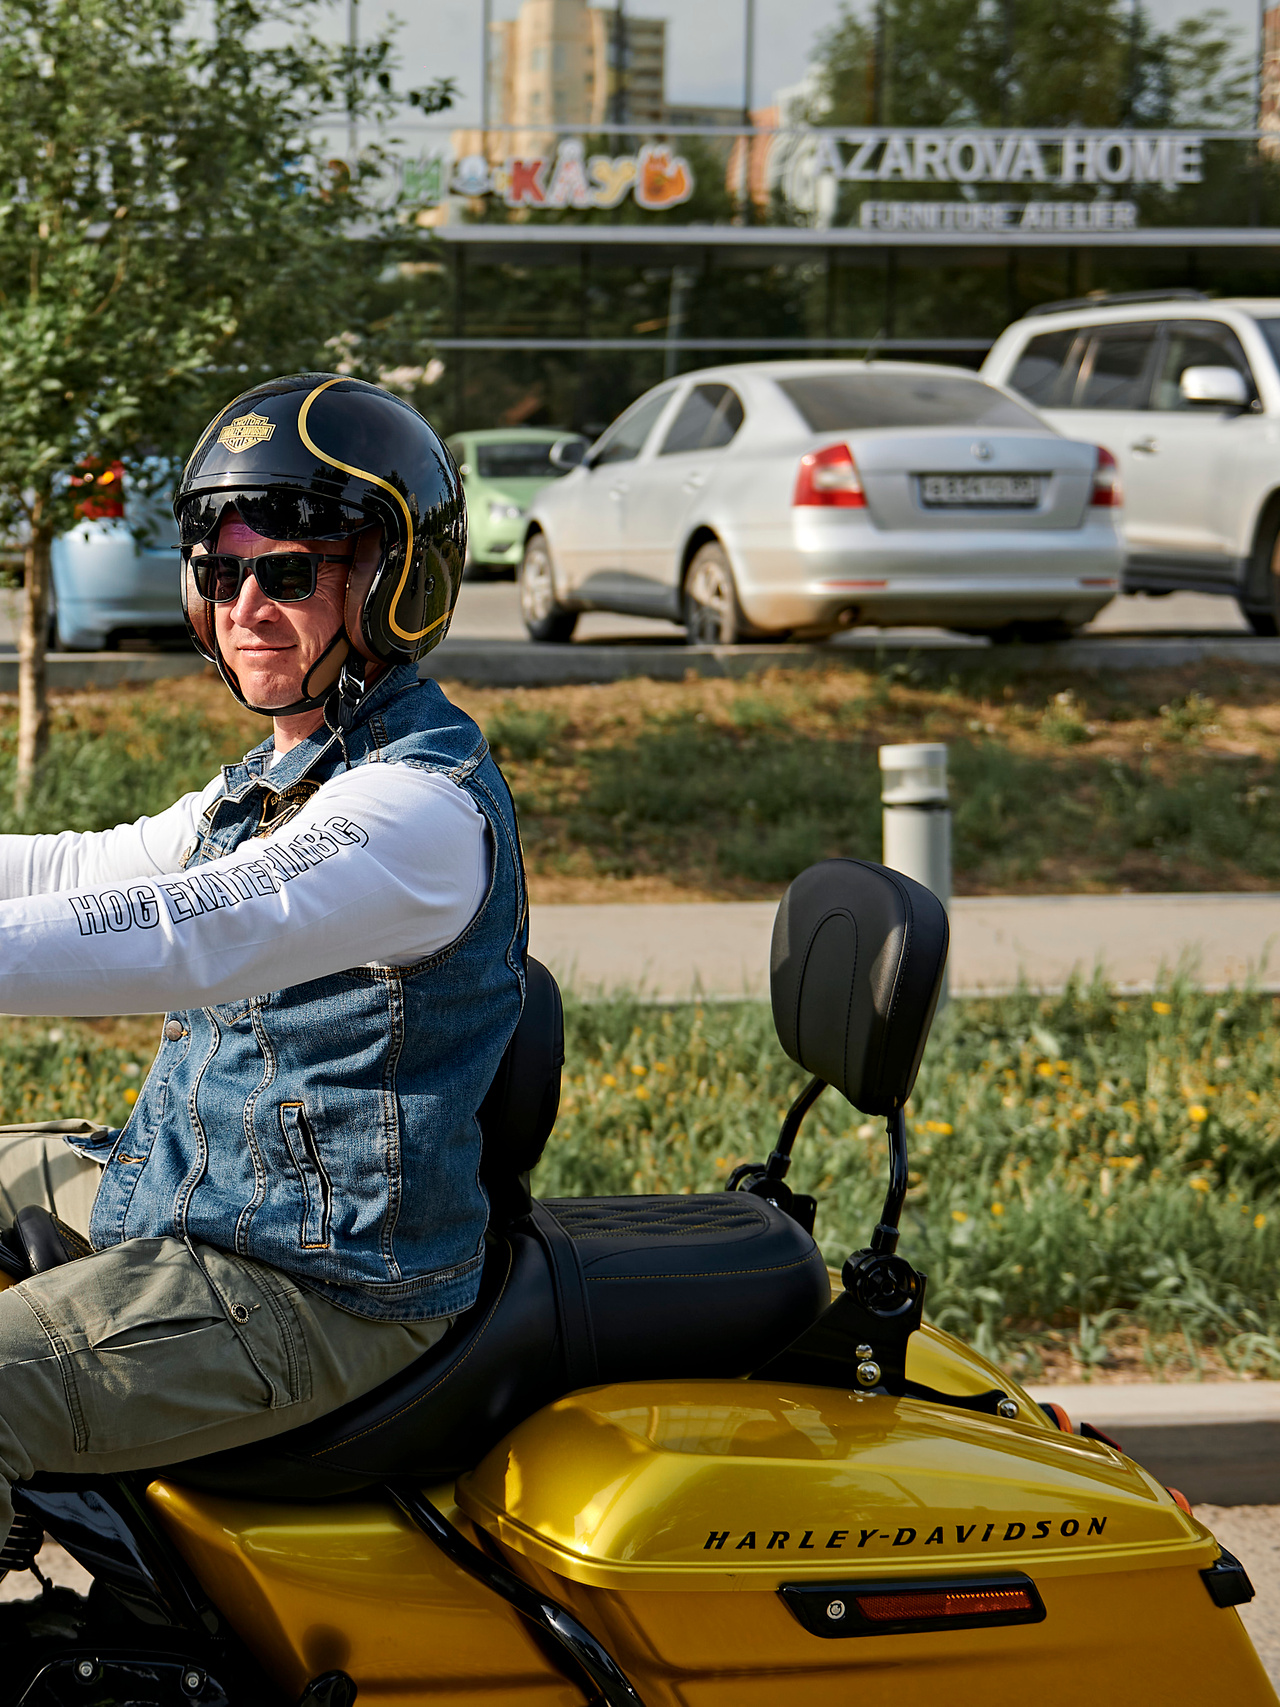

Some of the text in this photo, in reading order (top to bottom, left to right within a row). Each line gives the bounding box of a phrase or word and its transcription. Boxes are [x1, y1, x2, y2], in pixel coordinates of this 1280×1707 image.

[1060, 135, 1204, 182] HOME
[859, 201, 1138, 229] FURNITURE ATELIER
[68, 885, 160, 936] HOG
[703, 1516, 1108, 1550] HARLEY-DAVIDSON
